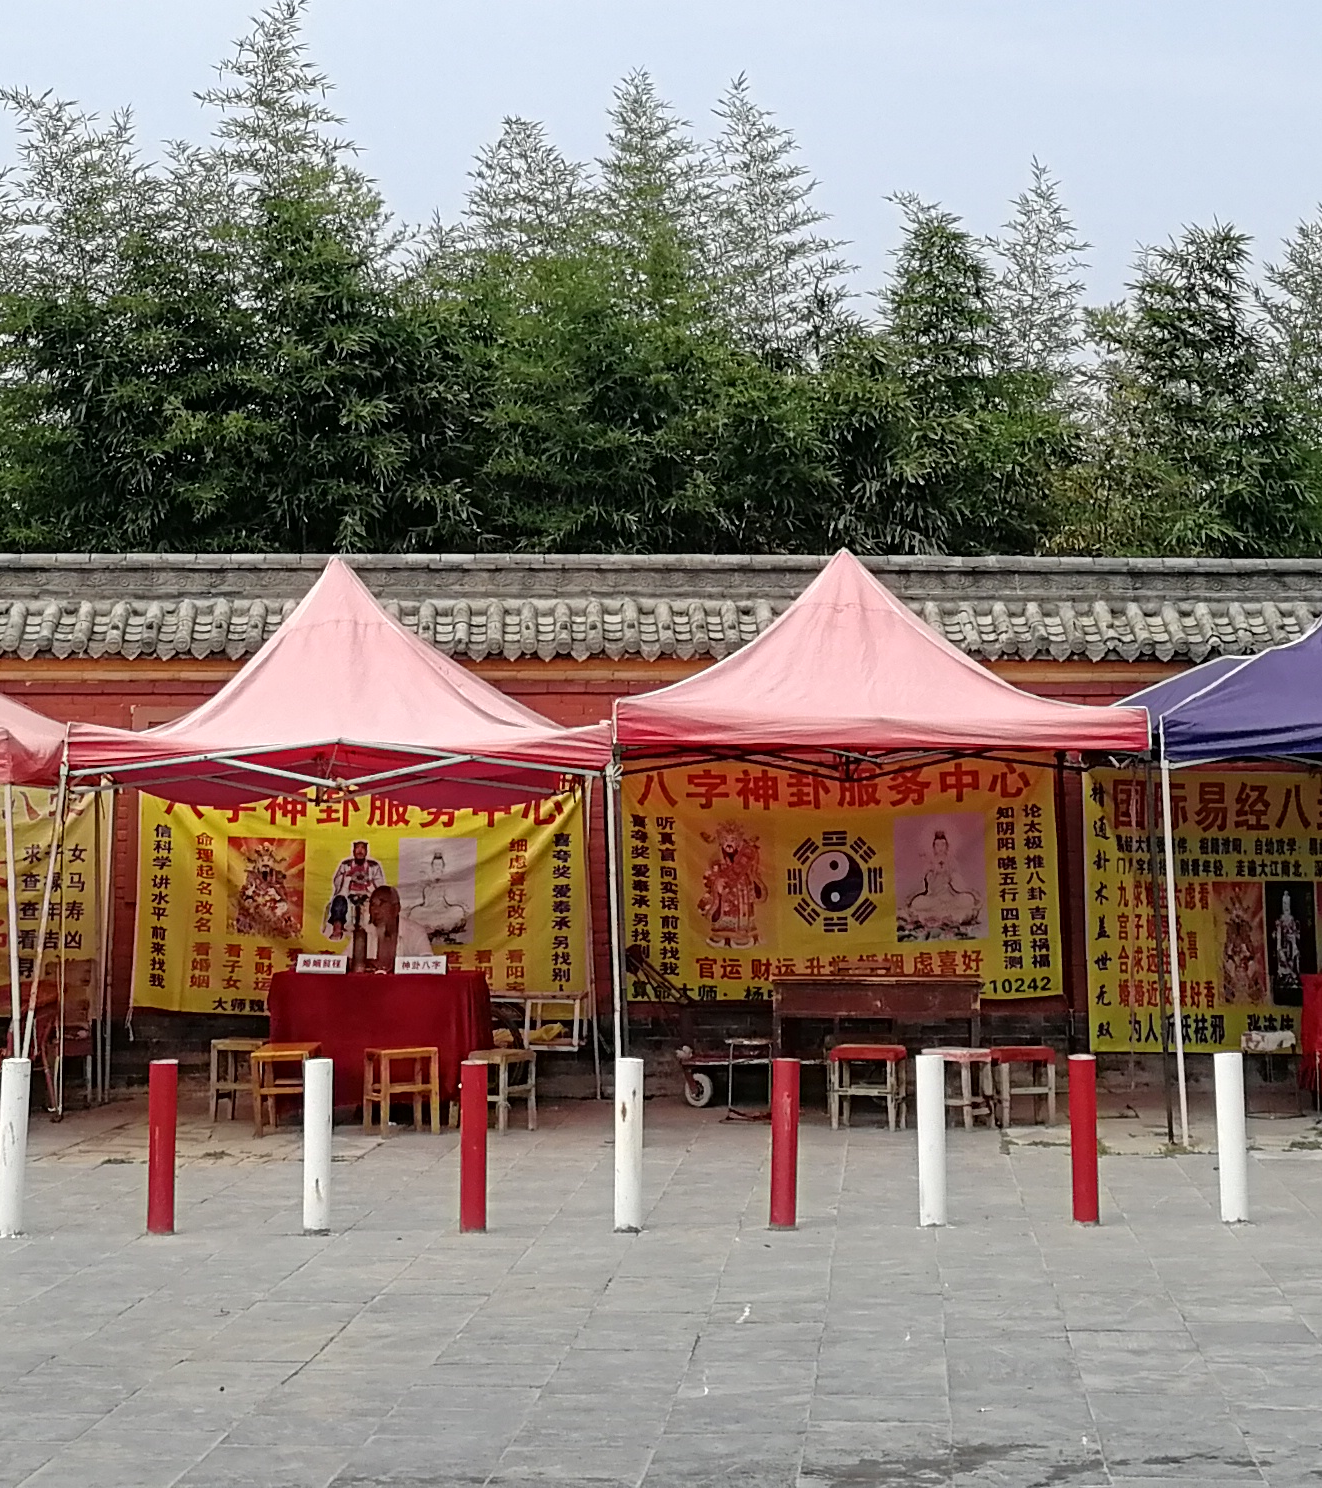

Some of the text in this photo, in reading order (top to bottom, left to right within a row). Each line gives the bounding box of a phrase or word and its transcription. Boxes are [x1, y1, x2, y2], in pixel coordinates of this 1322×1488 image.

[637, 764, 1032, 810] 八字神卦服务中心
